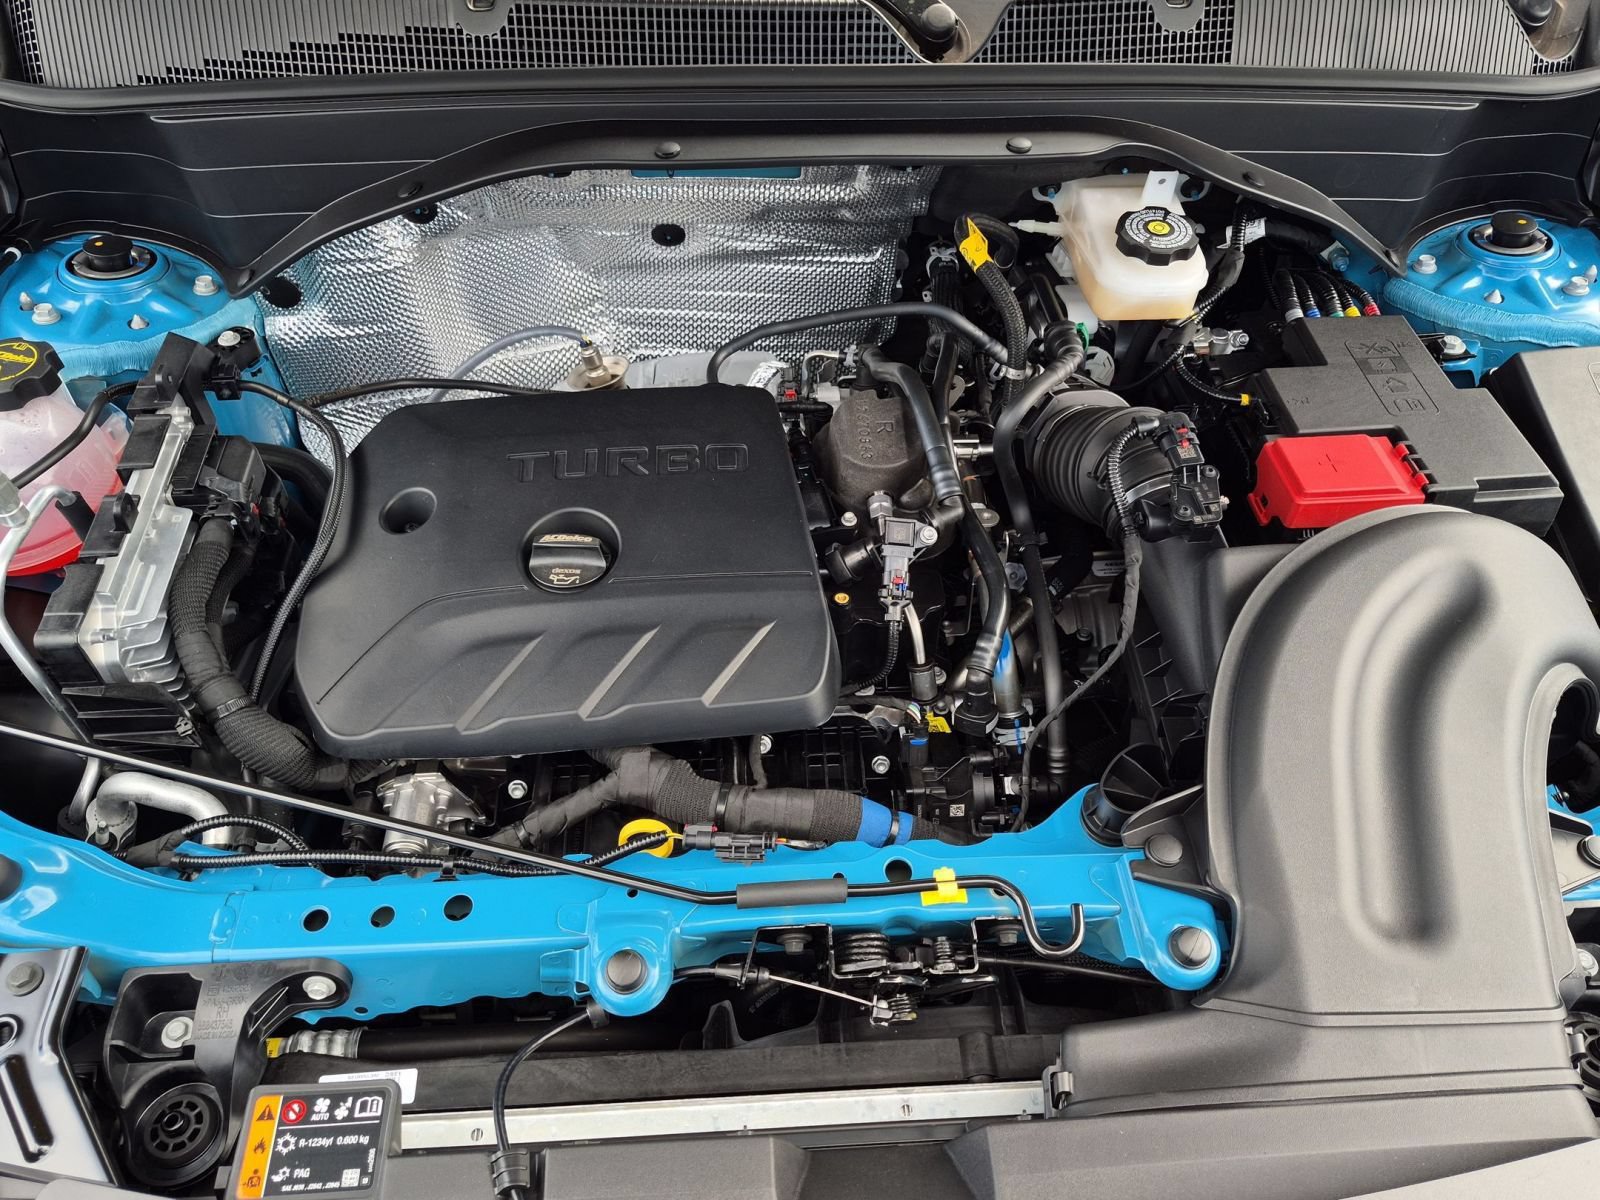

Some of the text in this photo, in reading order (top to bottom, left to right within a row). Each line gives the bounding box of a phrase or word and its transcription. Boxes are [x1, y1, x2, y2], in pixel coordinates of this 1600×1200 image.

[875, 420, 895, 434] R
[506, 443, 749, 483] TURBO
[539, 534, 593, 543] ACDelco
[551, 567, 582, 575] dexos
[310, 1113, 330, 1121] AUTO
[298, 1136, 334, 1148] R-1234yf
[359, 1134, 370, 1146] kg
[293, 1167, 311, 1179] PAG
